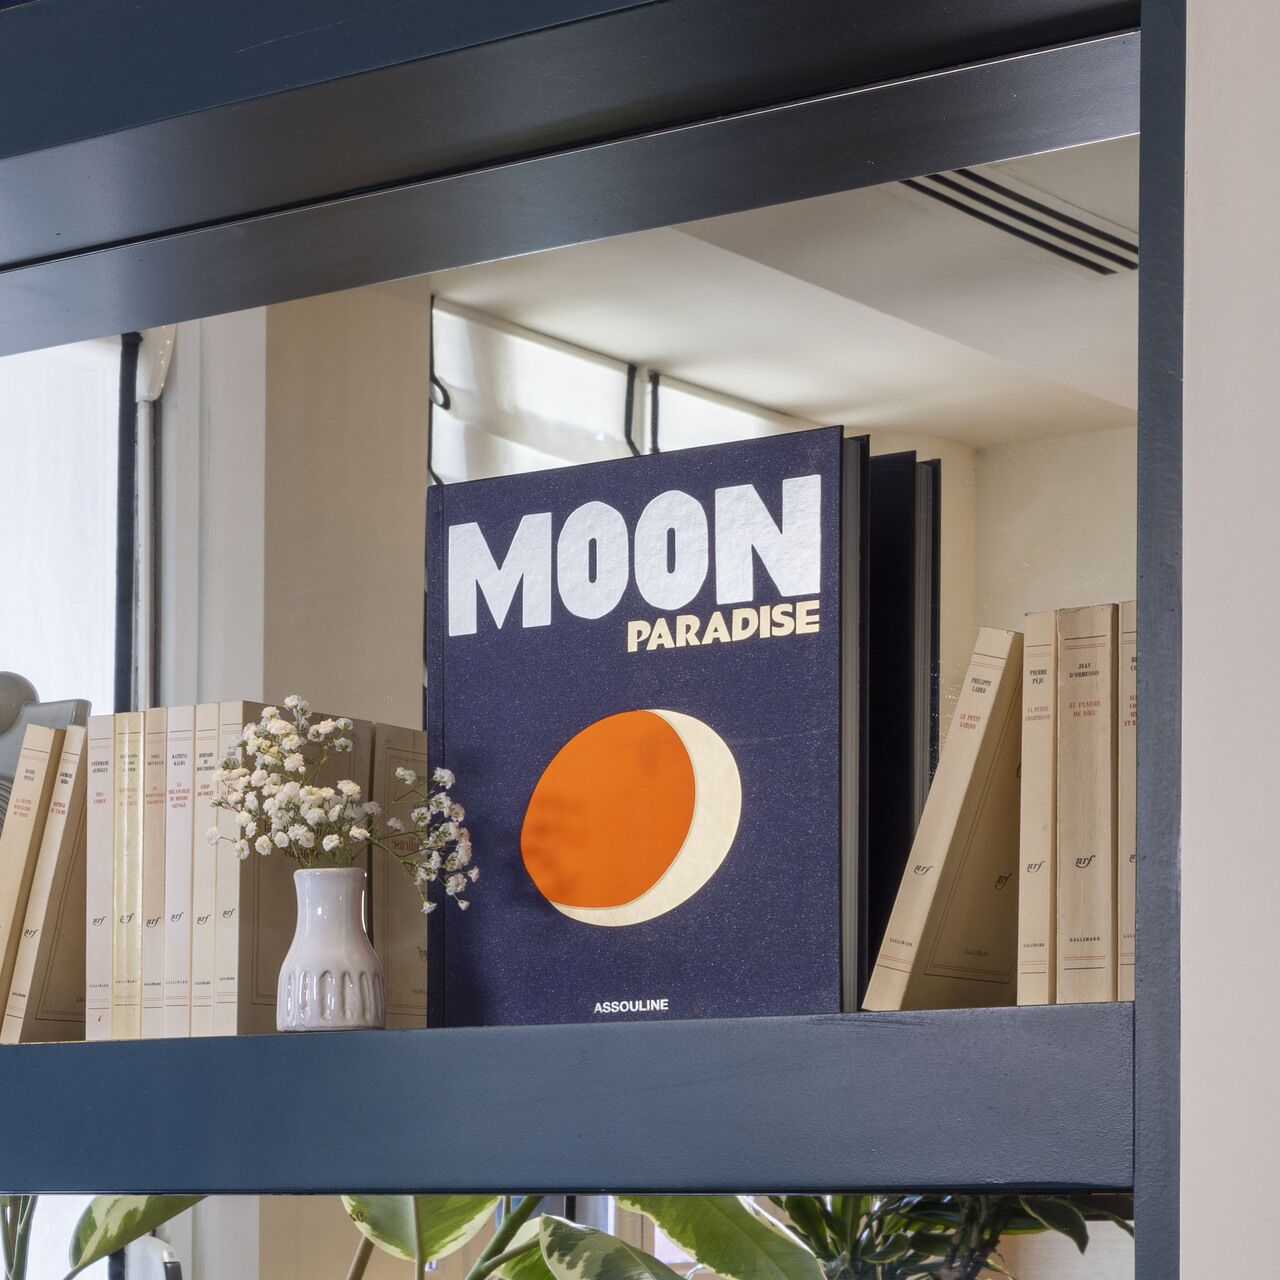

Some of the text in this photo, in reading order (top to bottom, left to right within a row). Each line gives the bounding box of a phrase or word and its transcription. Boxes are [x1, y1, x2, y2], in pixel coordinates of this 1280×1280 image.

[448, 474, 821, 636] MOON
[627, 600, 820, 652] PARADISE
[594, 999, 669, 1013] ASSOULINE
